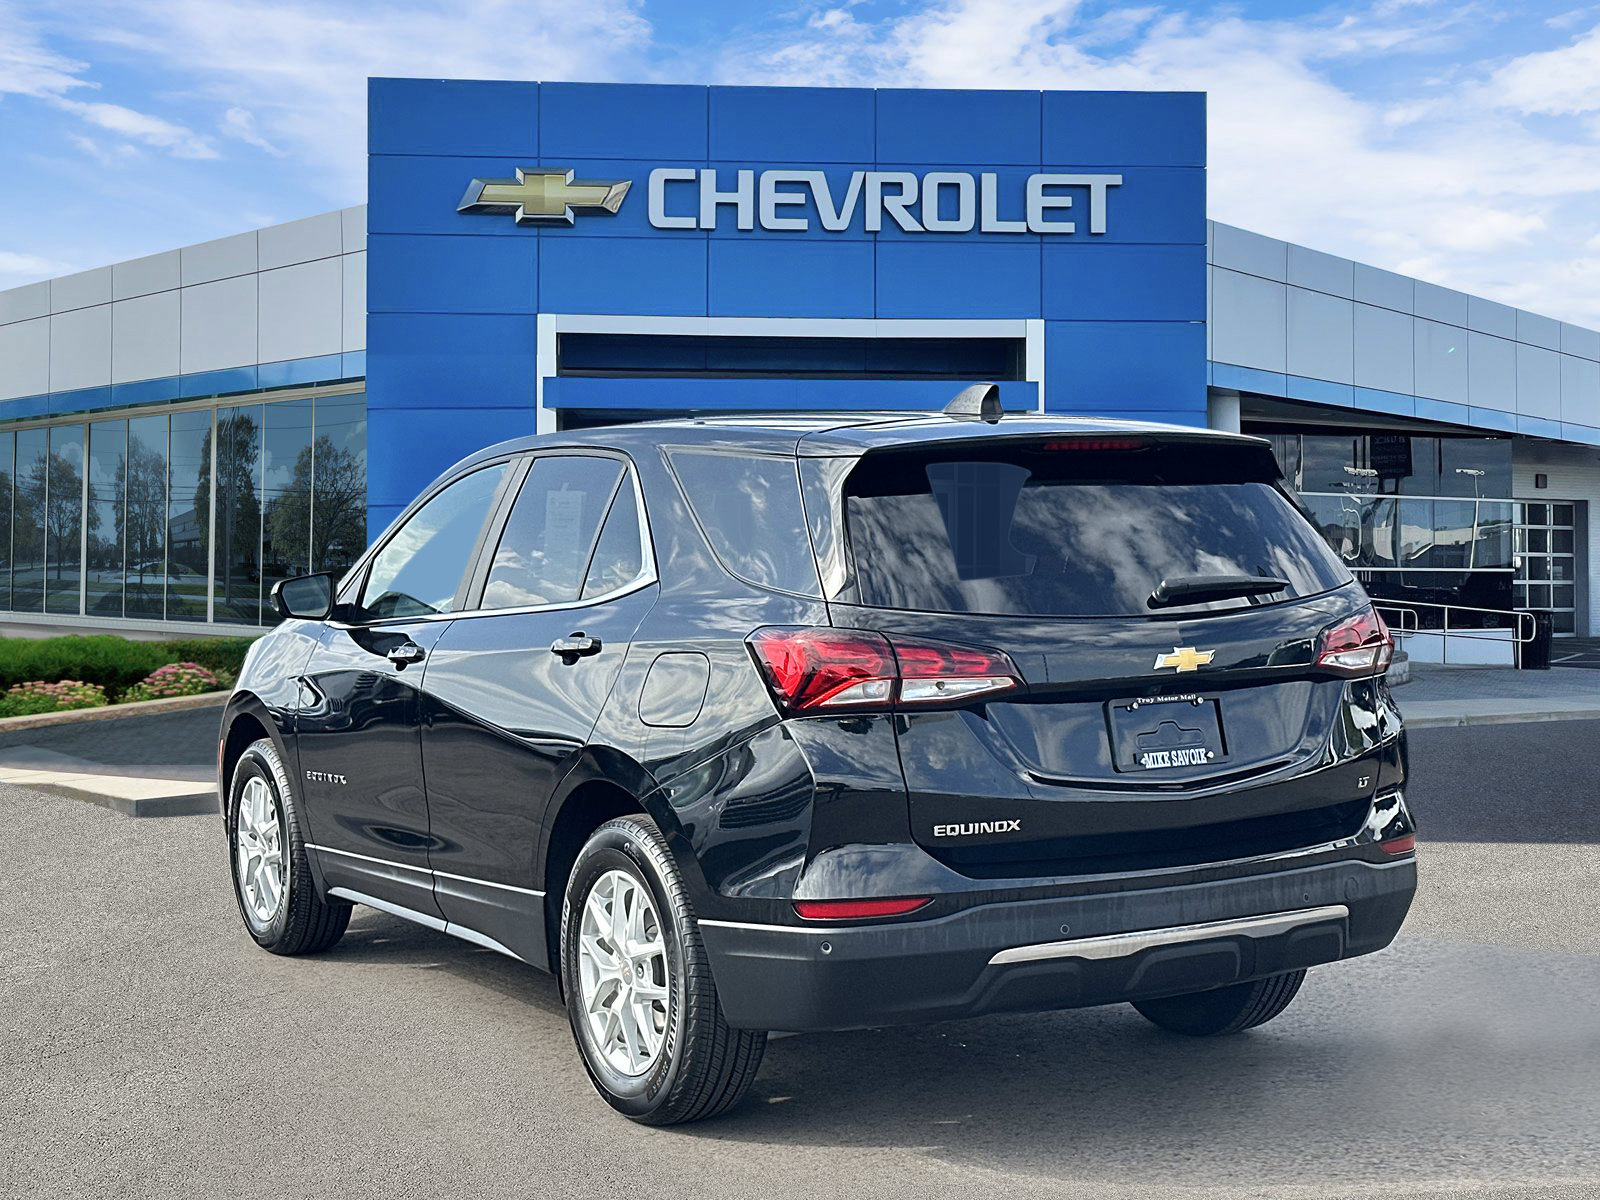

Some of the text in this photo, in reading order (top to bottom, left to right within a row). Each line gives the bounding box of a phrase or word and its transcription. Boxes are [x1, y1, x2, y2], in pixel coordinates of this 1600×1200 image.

[648, 168, 1123, 234] CHEVROLET
[1144, 748, 1207, 768] MIKE SAVOIE
[933, 819, 1021, 837] EQUINOX
[667, 973, 678, 1054] MICHELIN
